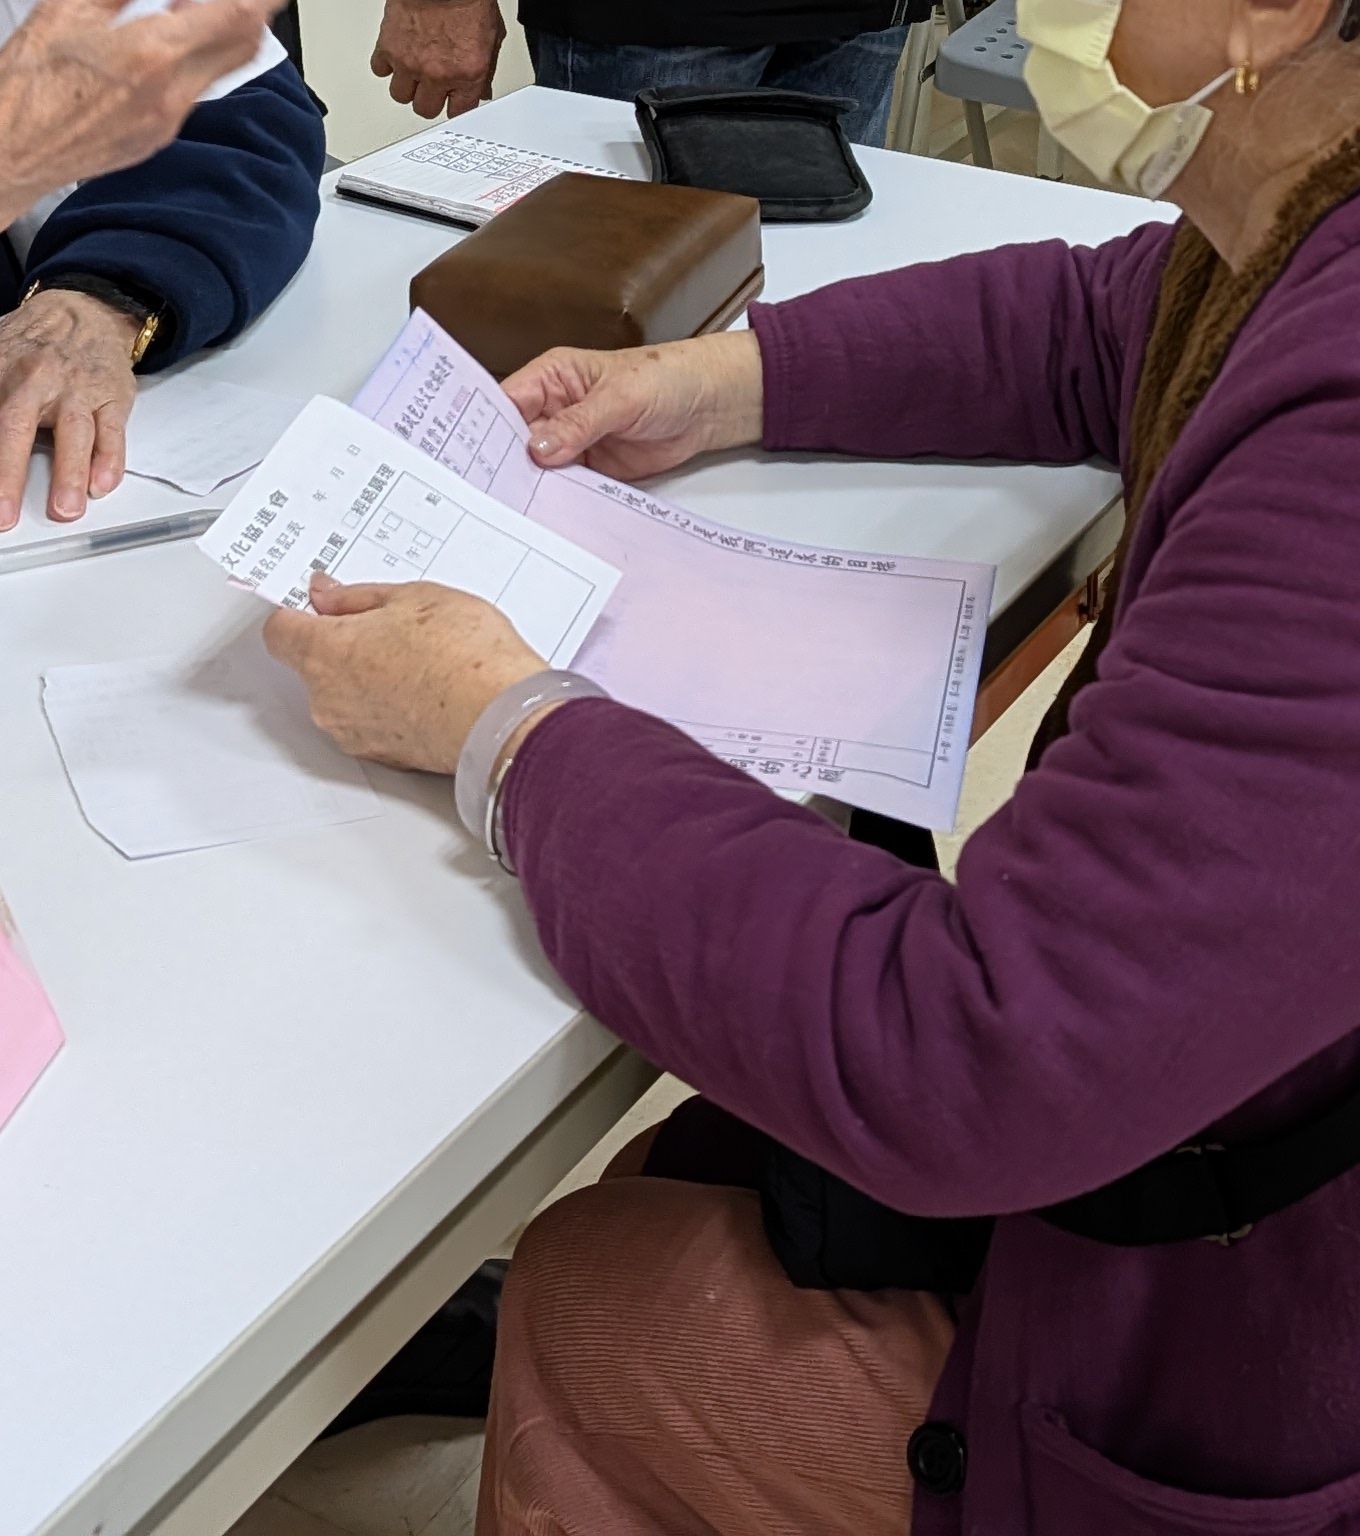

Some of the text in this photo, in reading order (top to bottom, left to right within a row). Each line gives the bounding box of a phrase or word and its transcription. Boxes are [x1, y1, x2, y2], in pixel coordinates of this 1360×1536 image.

[220, 489, 289, 569] 文化協進會
